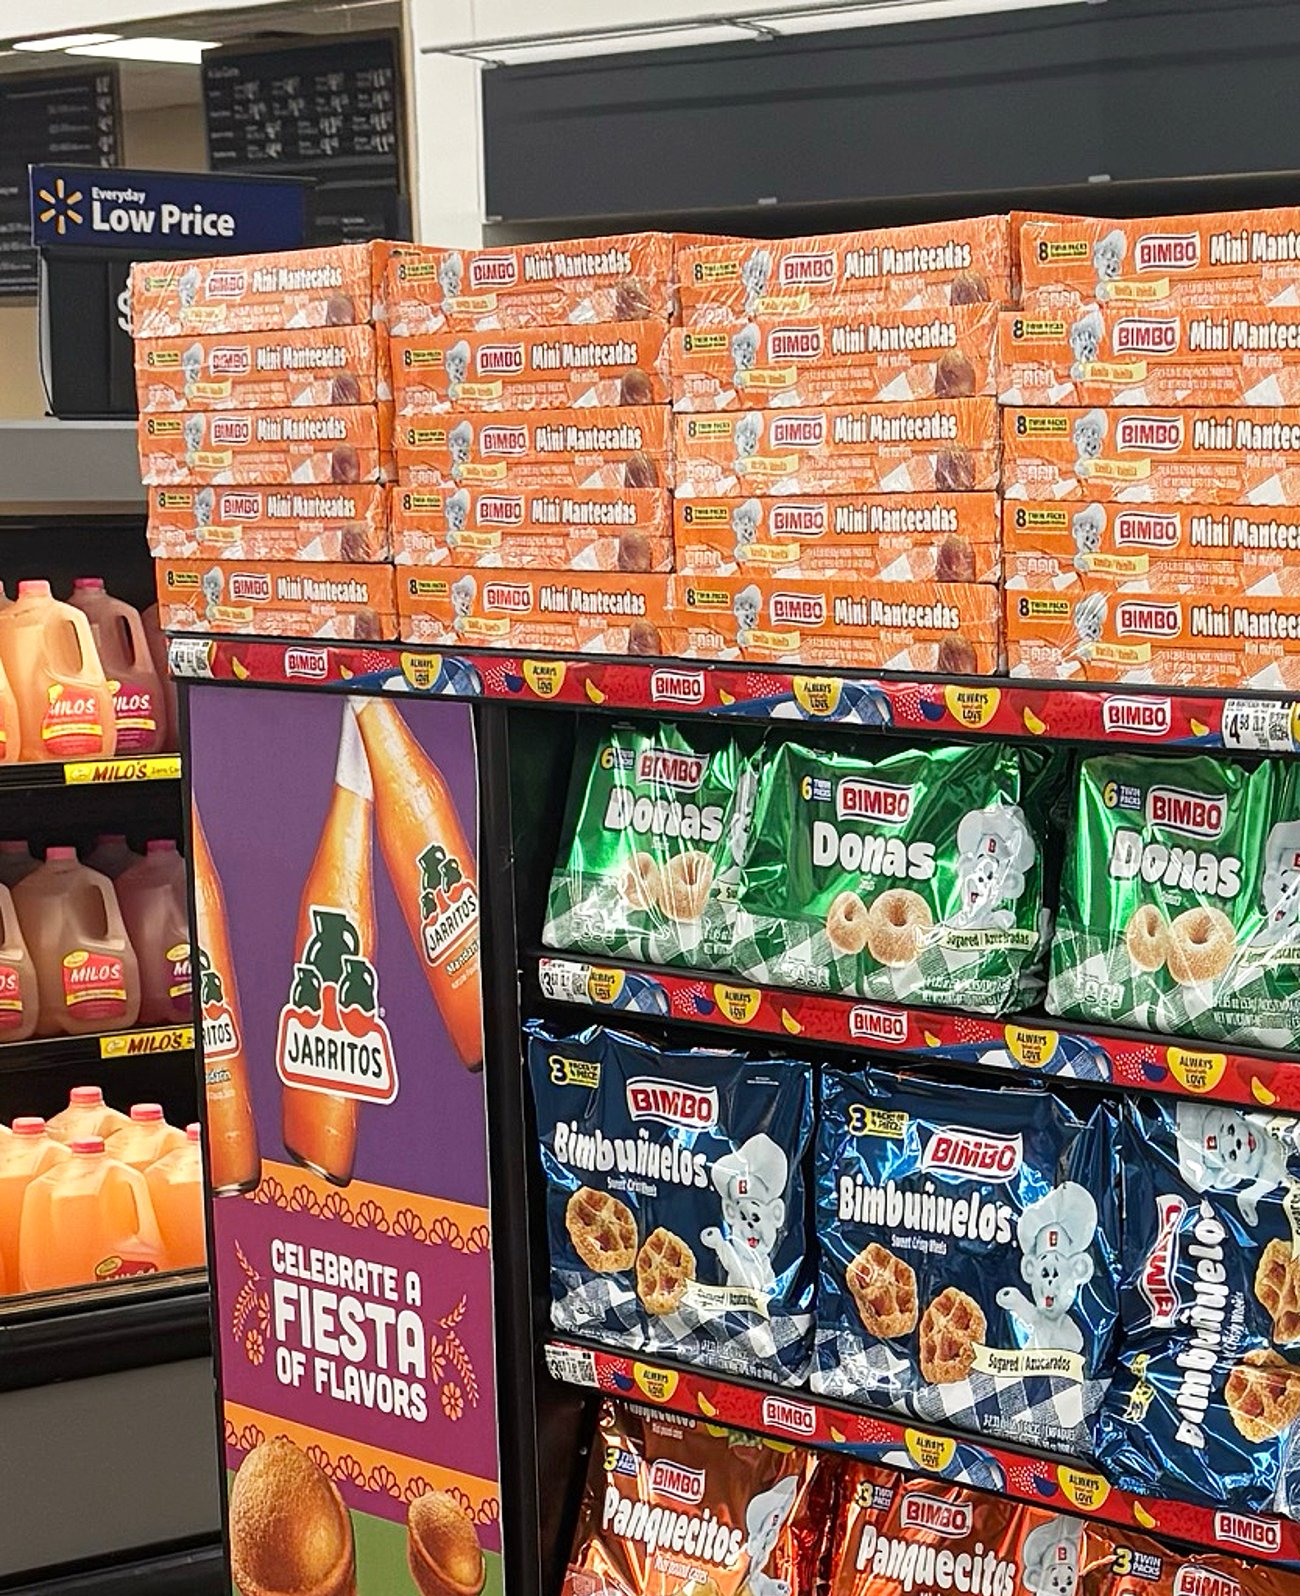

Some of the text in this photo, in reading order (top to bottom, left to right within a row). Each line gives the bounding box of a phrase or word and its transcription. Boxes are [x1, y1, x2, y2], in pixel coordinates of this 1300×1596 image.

[92, 188, 145, 203] Everyday
[92, 206, 235, 236] Low Price
[1141, 239, 1196, 266] BIMBO
[1210, 235, 1247, 264] Mini
[1121, 423, 1180, 447] BIMBO
[1194, 419, 1232, 449] Mini
[775, 510, 824, 533] BIMBO
[835, 503, 957, 533] Mini Mantecadas
[289, 653, 325, 672] BIMBO
[656, 677, 700, 696] BIMBO
[1109, 704, 1166, 725] BIMBO
[641, 753, 702, 784] BIMBO
[802, 776, 812, 799] 6
[842, 785, 910, 816] BIMBO
[1104, 782, 1119, 807] 6
[604, 787, 723, 842] Donas
[1152, 795, 1221, 830] BIMBO
[813, 821, 936, 878] Donas
[1109, 830, 1242, 897] Donas
[429, 895, 476, 951] JARRITOS
[854, 1015, 903, 1036] BIMBO
[1017, 1033, 1047, 1046] ALWAYS
[289, 1032, 382, 1078] JARRITOS
[1022, 1050, 1040, 1062] LOVE
[1180, 1057, 1213, 1070] ALWAYS
[1186, 1075, 1206, 1087] LOVE
[631, 1088, 712, 1122] BIMBO
[851, 1106, 866, 1132] 3
[555, 1121, 710, 1188] Bimbuñuelos
[931, 1137, 1017, 1172] BIMBO
[840, 1177, 1012, 1244] Bimbuñuelos
[271, 1239, 421, 1306] CELEBRATE A
[274, 1279, 426, 1378] FIESTA
[277, 1347, 427, 1422] OF FLAVORS
[653, 1467, 701, 1496] BIMBO
[603, 1486, 743, 1567] Panquecitos
[907, 1501, 967, 1531] BIMBO
[1221, 1516, 1276, 1546] BIMBO
[1112, 1549, 1131, 1573] 3
[1133, 1562, 1160, 1576] PACKS
[1134, 1552, 1161, 1566] TWIN
